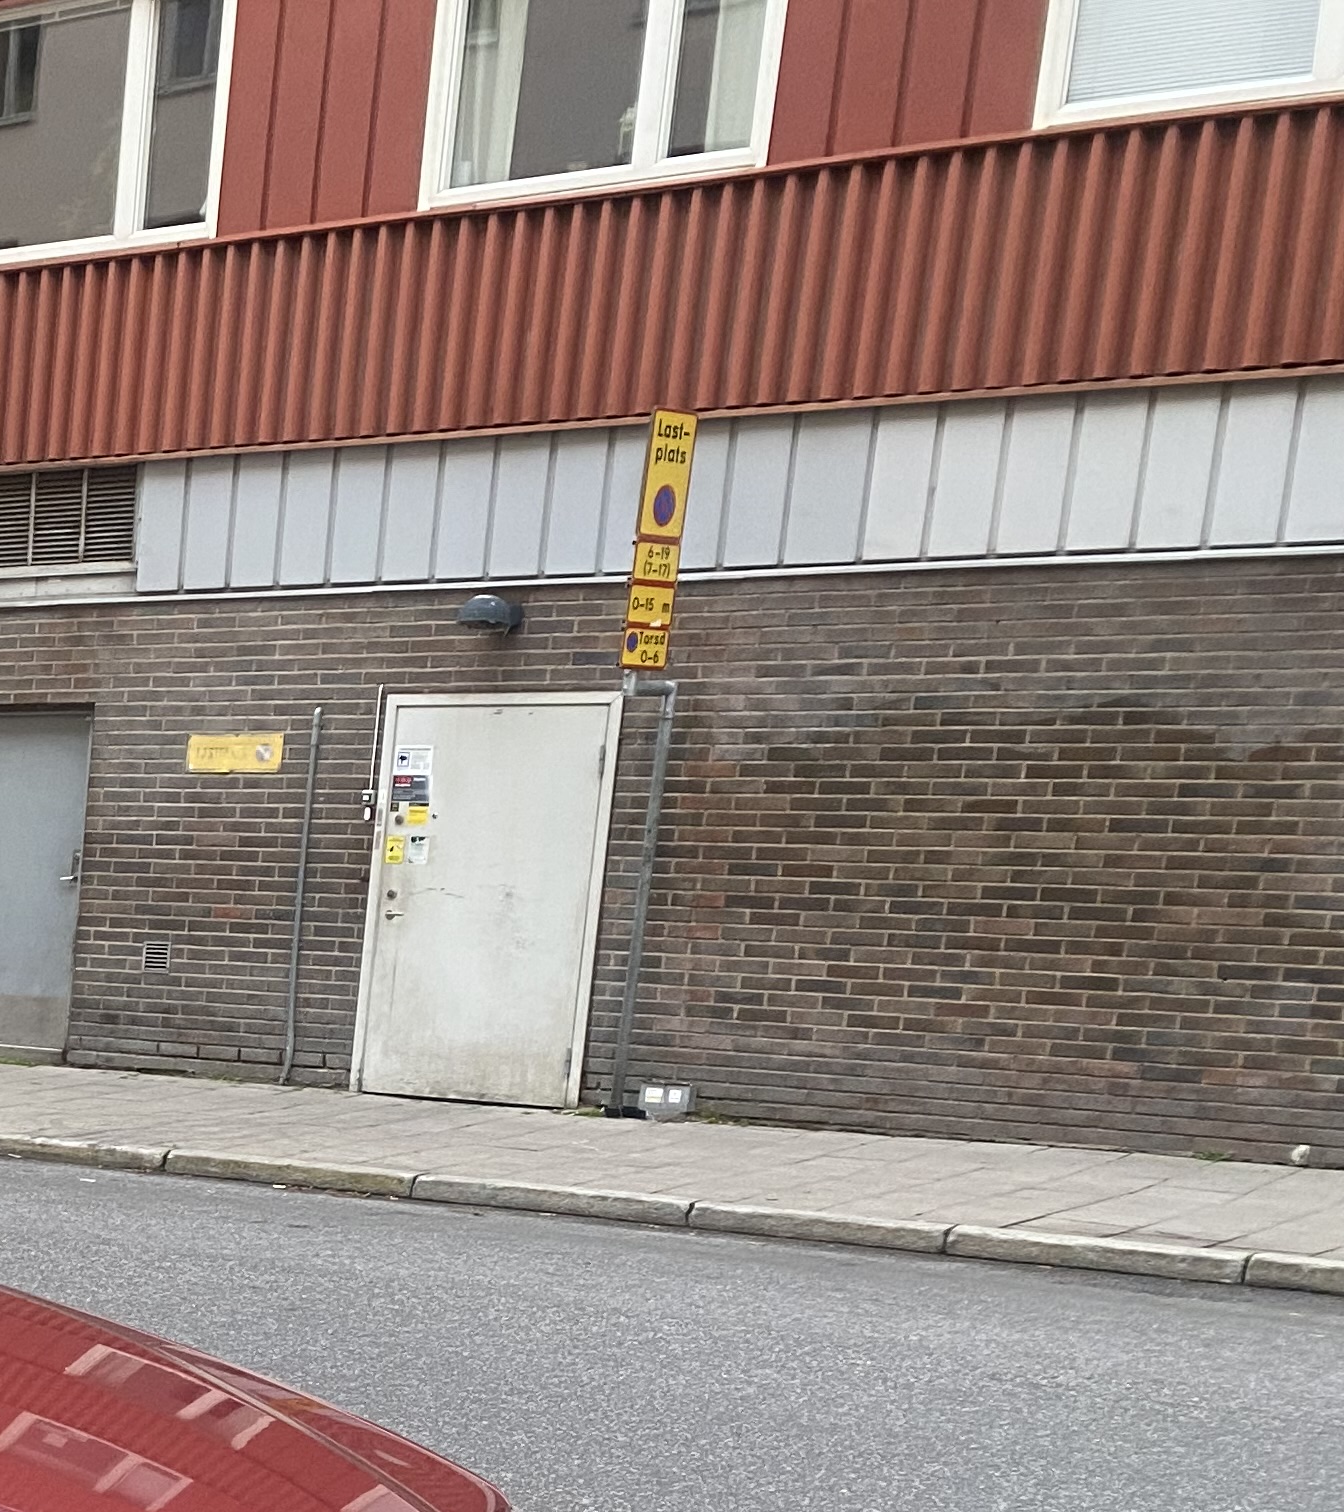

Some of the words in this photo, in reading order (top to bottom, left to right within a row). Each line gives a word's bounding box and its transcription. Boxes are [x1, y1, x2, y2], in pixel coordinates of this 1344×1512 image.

[657, 418, 691, 441] Last-
[655, 446, 687, 465] plats
[643, 560, 671, 579] (7-17)
[632, 597, 655, 612] 0-15
[661, 602, 670, 614] m
[638, 631, 666, 646] Torsd
[640, 651, 660, 664] 0-6
